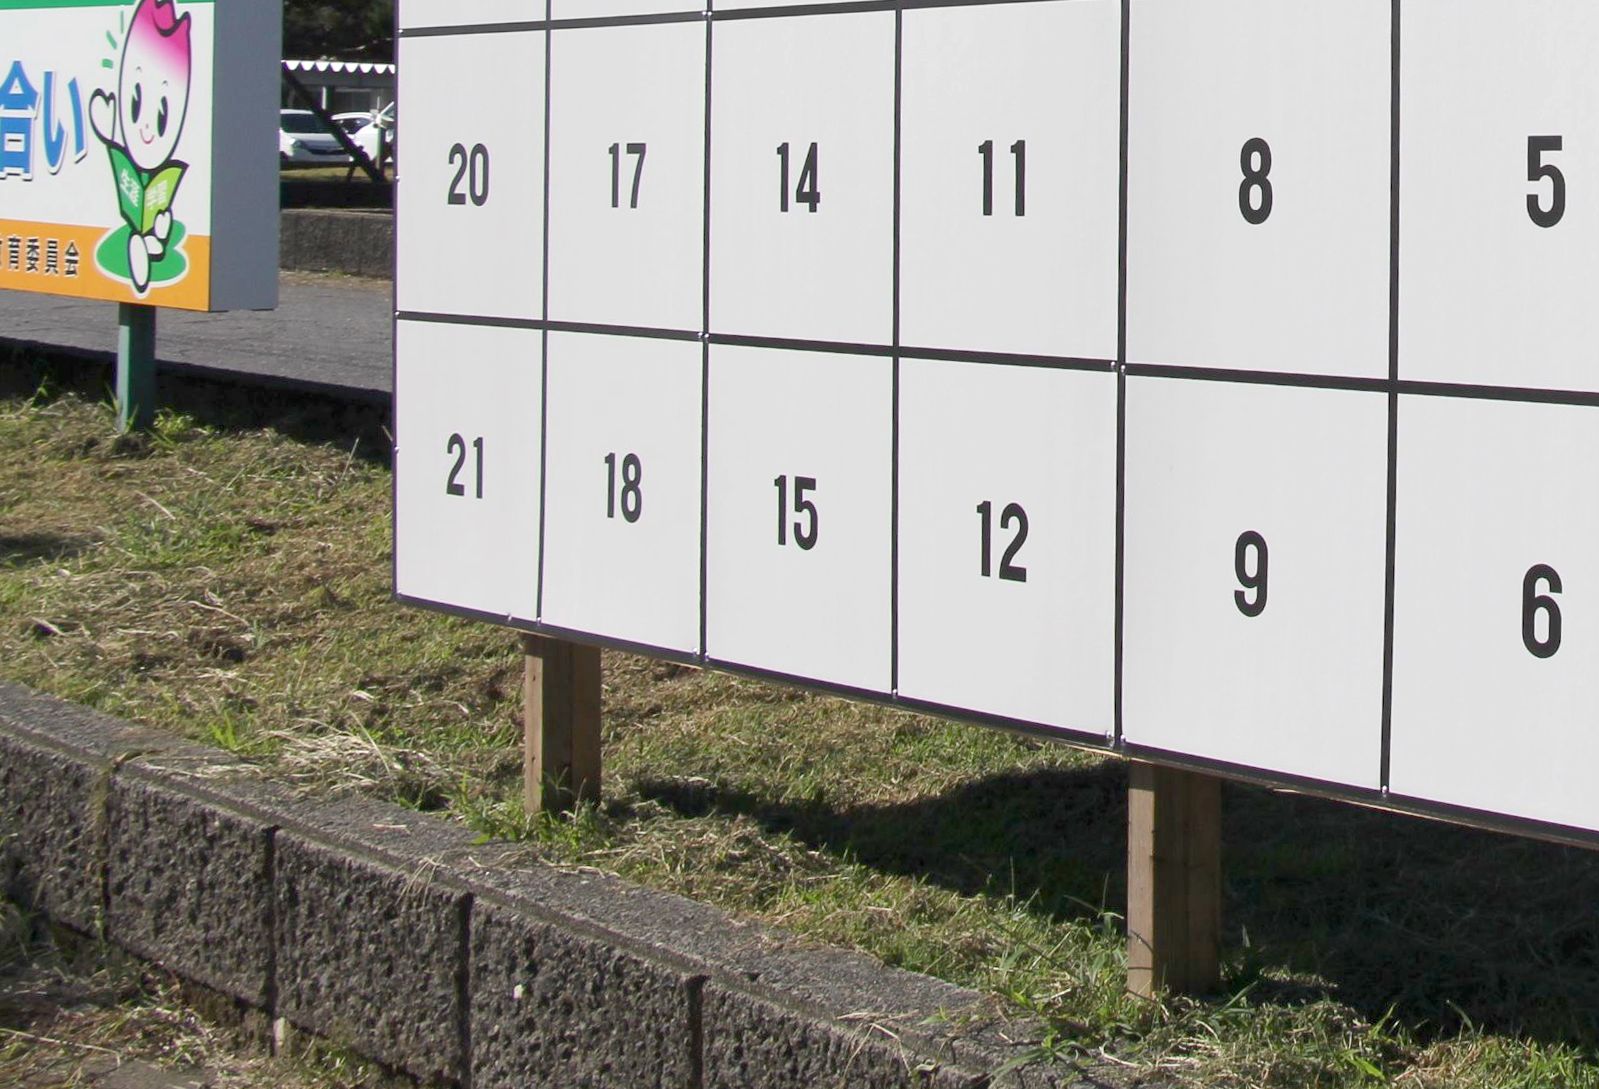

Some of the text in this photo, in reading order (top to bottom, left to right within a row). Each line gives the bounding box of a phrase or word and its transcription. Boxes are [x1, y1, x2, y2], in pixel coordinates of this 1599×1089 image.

[447, 142, 490, 207] 20
[608, 142, 647, 209] 17
[776, 141, 821, 213] 14
[978, 139, 1026, 217] 11
[1238, 137, 1273, 225] 8
[1526, 135, 1566, 229] 5
[0, 235, 80, 278] 育委員会
[446, 432, 484, 499] 21
[604, 452, 642, 524] 18
[773, 474, 819, 551] 15
[976, 500, 1029, 583] 12
[1233, 530, 1269, 618] 9
[1521, 563, 1563, 659] 6
